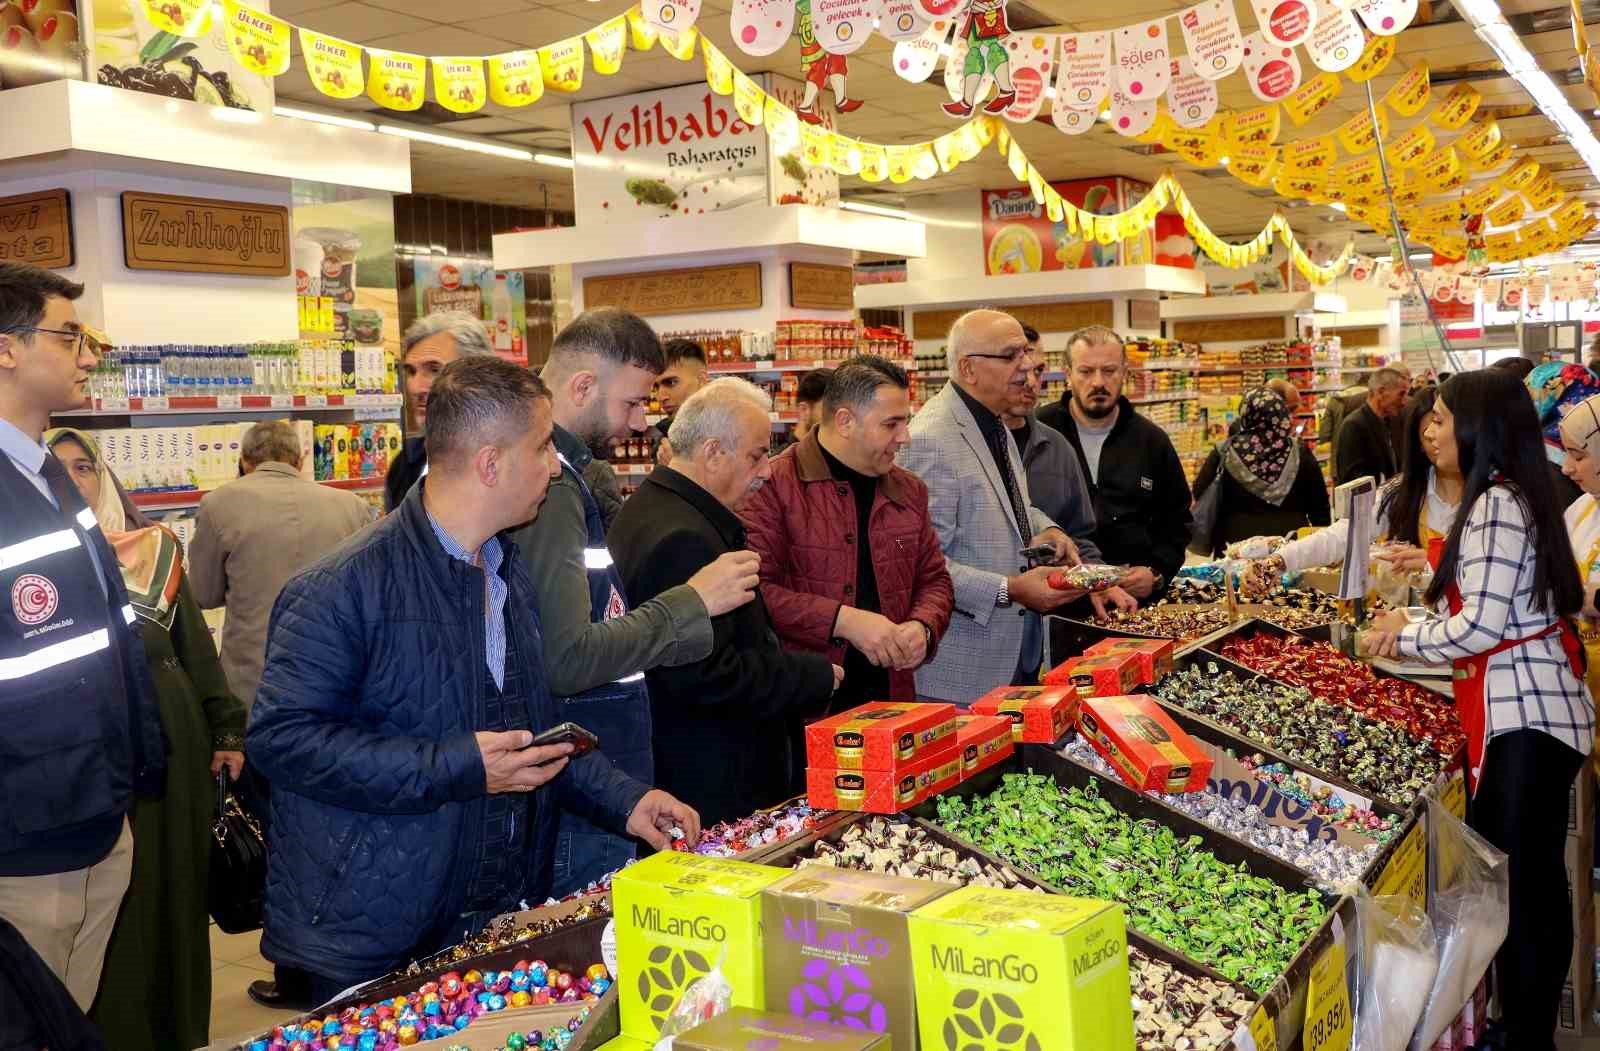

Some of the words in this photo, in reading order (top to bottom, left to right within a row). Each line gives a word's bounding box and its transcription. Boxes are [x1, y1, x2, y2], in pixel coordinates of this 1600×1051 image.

[826, 7, 863, 24] gelecek
[888, 3, 914, 16] gelec
[238, 10, 273, 34] ÜLKER
[315, 39, 347, 58] ÜLKER
[384, 56, 414, 71] ÜLKER
[446, 64, 472, 73] ÜLKER
[503, 59, 529, 71] ÜLKER
[667, 144, 756, 167] Baharatçısı
[991, 198, 1036, 216] Danino
[632, 903, 727, 942] MiLanGo
[930, 943, 1039, 985] MiLanGo
[1072, 937, 1121, 977] MiLanGo
